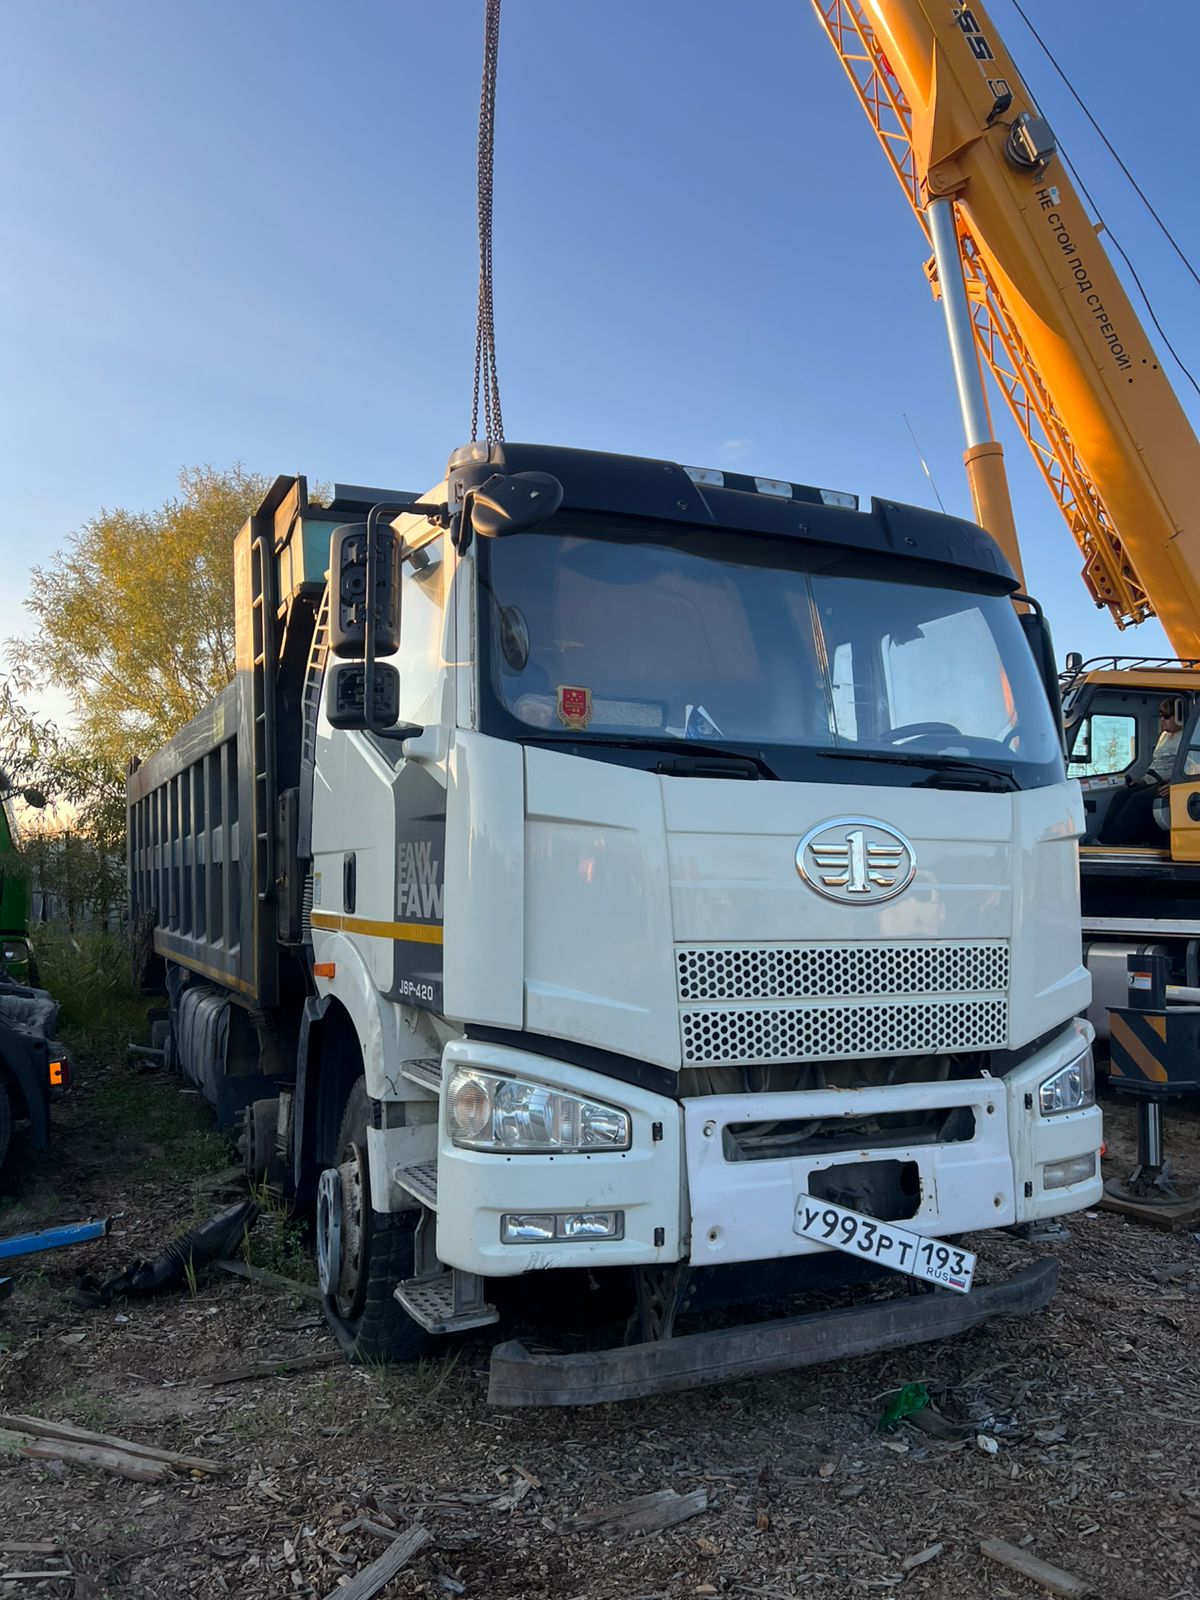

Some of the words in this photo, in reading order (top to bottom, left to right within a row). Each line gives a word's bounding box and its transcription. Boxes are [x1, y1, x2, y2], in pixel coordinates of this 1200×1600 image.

[1035, 188, 1055, 212] НЕ
[1047, 213, 1078, 256] СТОЙ
[1068, 257, 1093, 293] ПОД
[1086, 294, 1132, 371] СТРЕЛОЙ!
[397, 883, 446, 919] FAW
[399, 979, 434, 1001] J6P-420
[921, 1243, 966, 1276] 193
[926, 1266, 949, 1281] RUS
